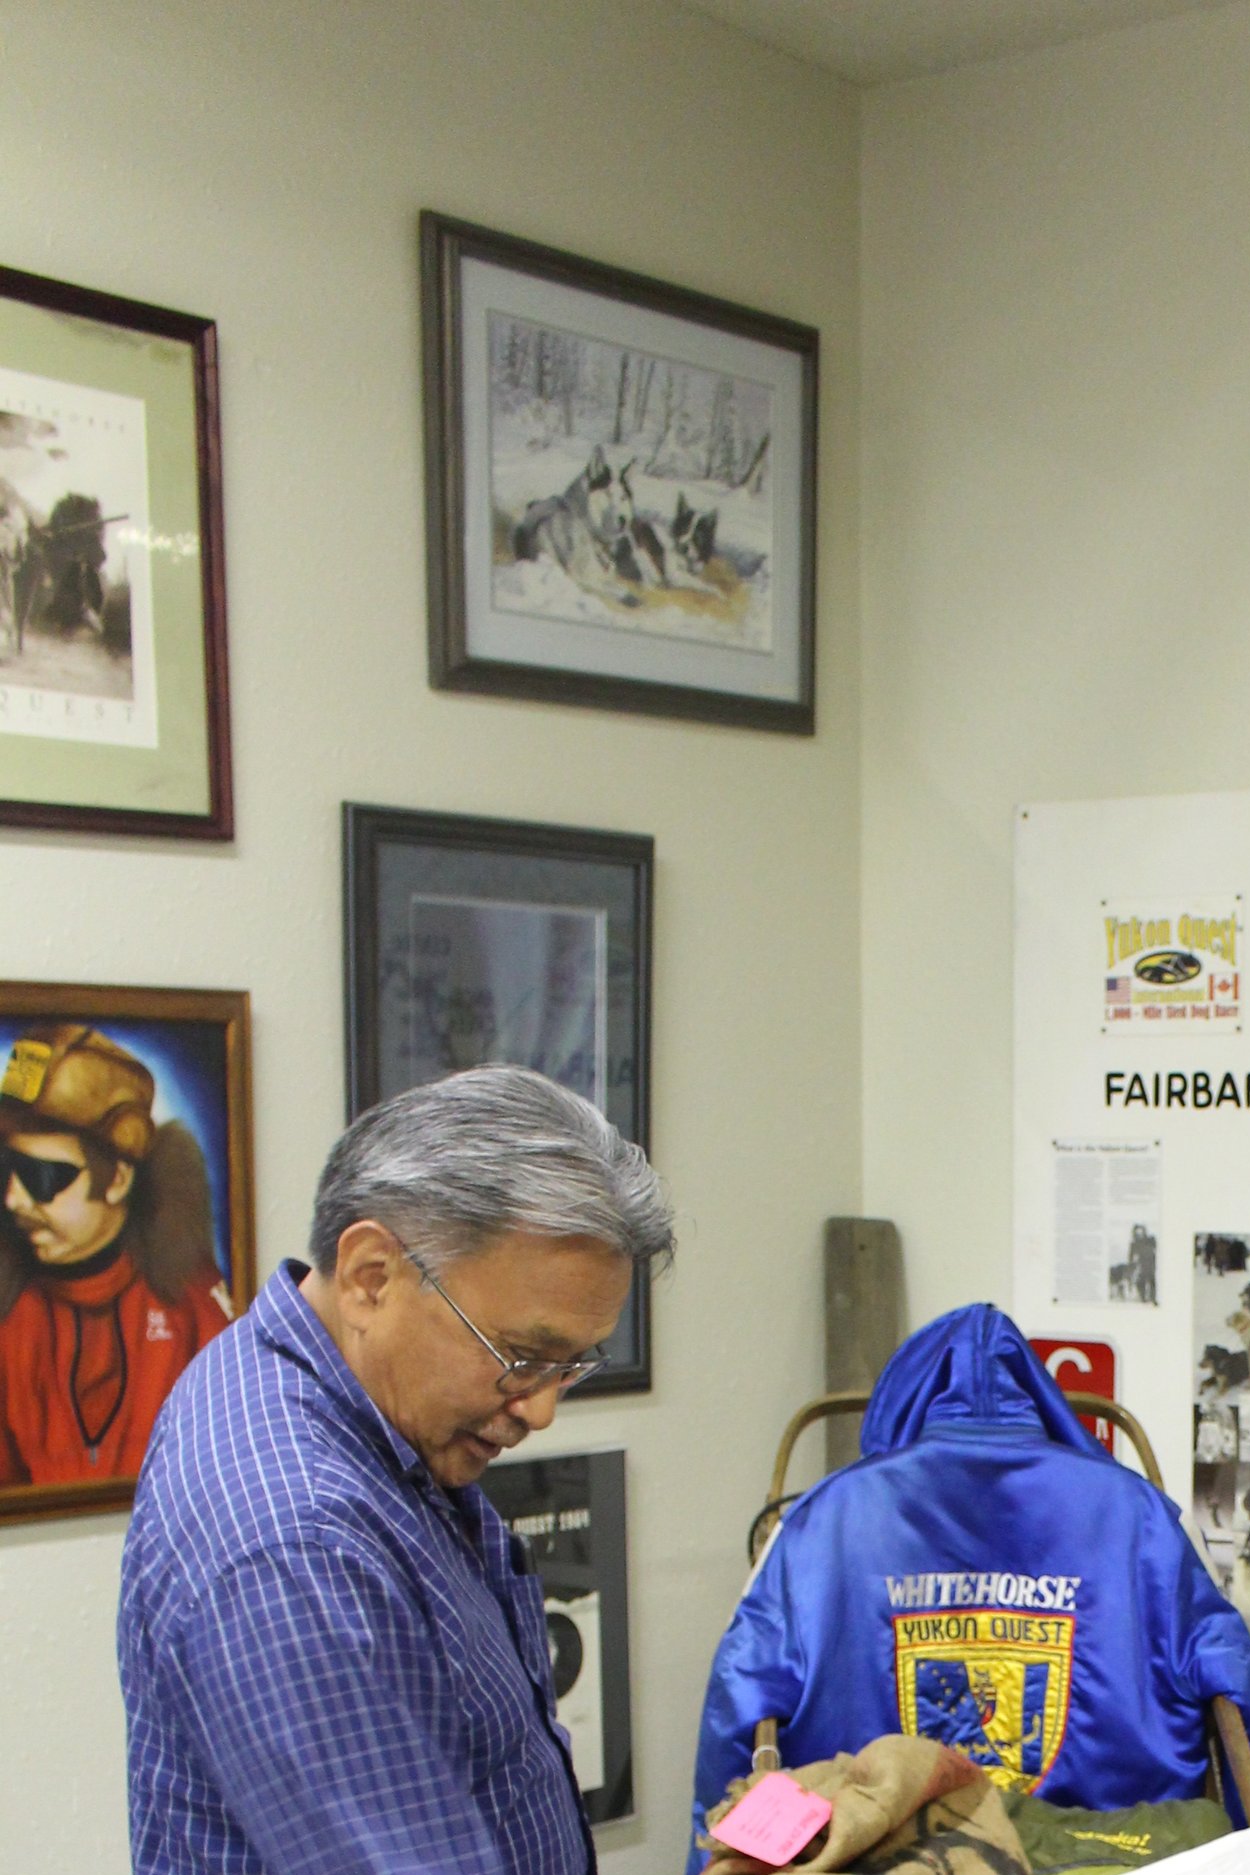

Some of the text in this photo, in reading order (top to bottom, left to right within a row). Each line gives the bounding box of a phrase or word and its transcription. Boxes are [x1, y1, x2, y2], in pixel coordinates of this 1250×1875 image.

[1104, 911, 1236, 970] Yukon Quest
[885, 1572, 1082, 1611] WHITEHORSE
[902, 1616, 1066, 1644] YUKON QUEST
